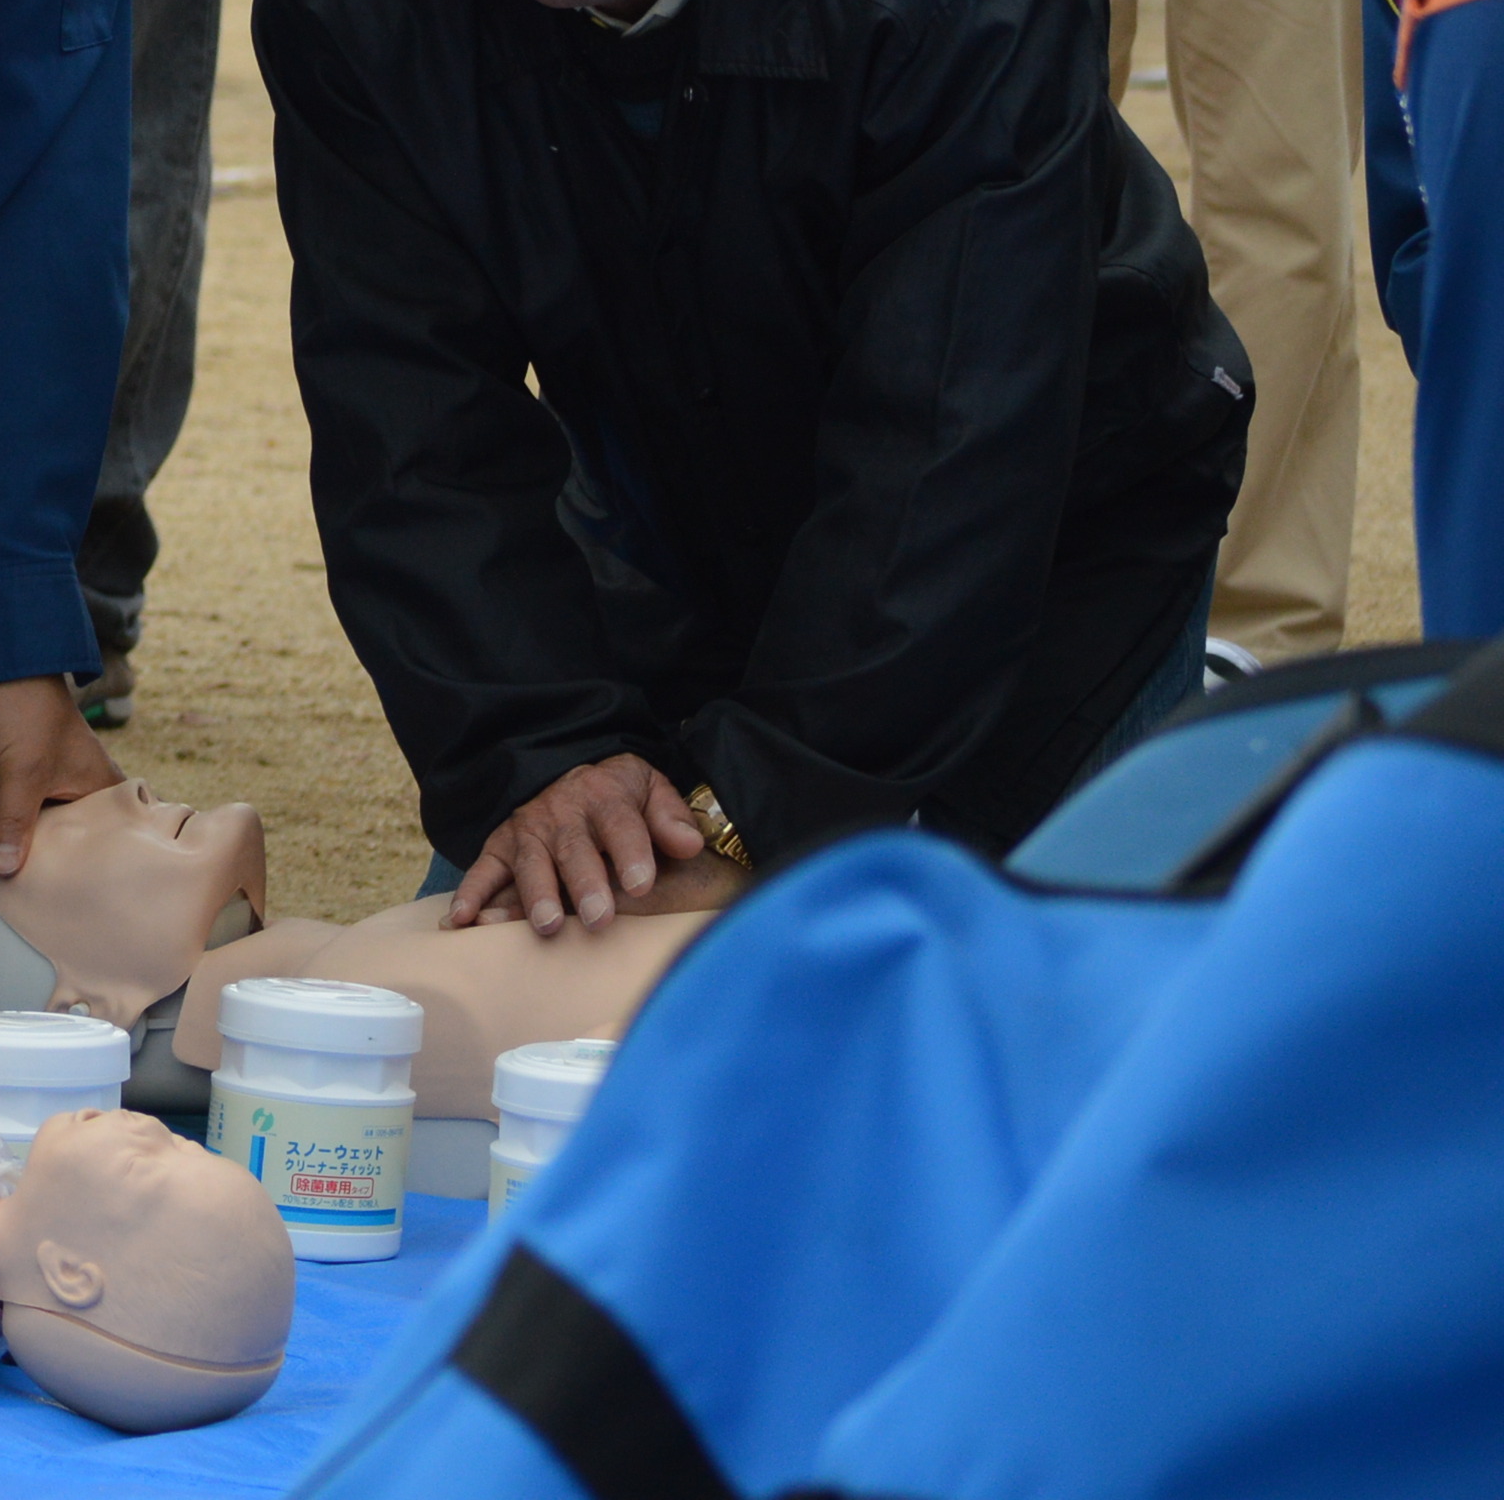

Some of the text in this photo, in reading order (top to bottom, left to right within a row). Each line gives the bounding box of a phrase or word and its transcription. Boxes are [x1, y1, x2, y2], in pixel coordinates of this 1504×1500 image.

[286, 1140, 384, 1161] スノーウェット
[285, 1157, 382, 1176] クリーナーティッシュ
[295, 1177, 371, 1196] 除菌専用タイプ
